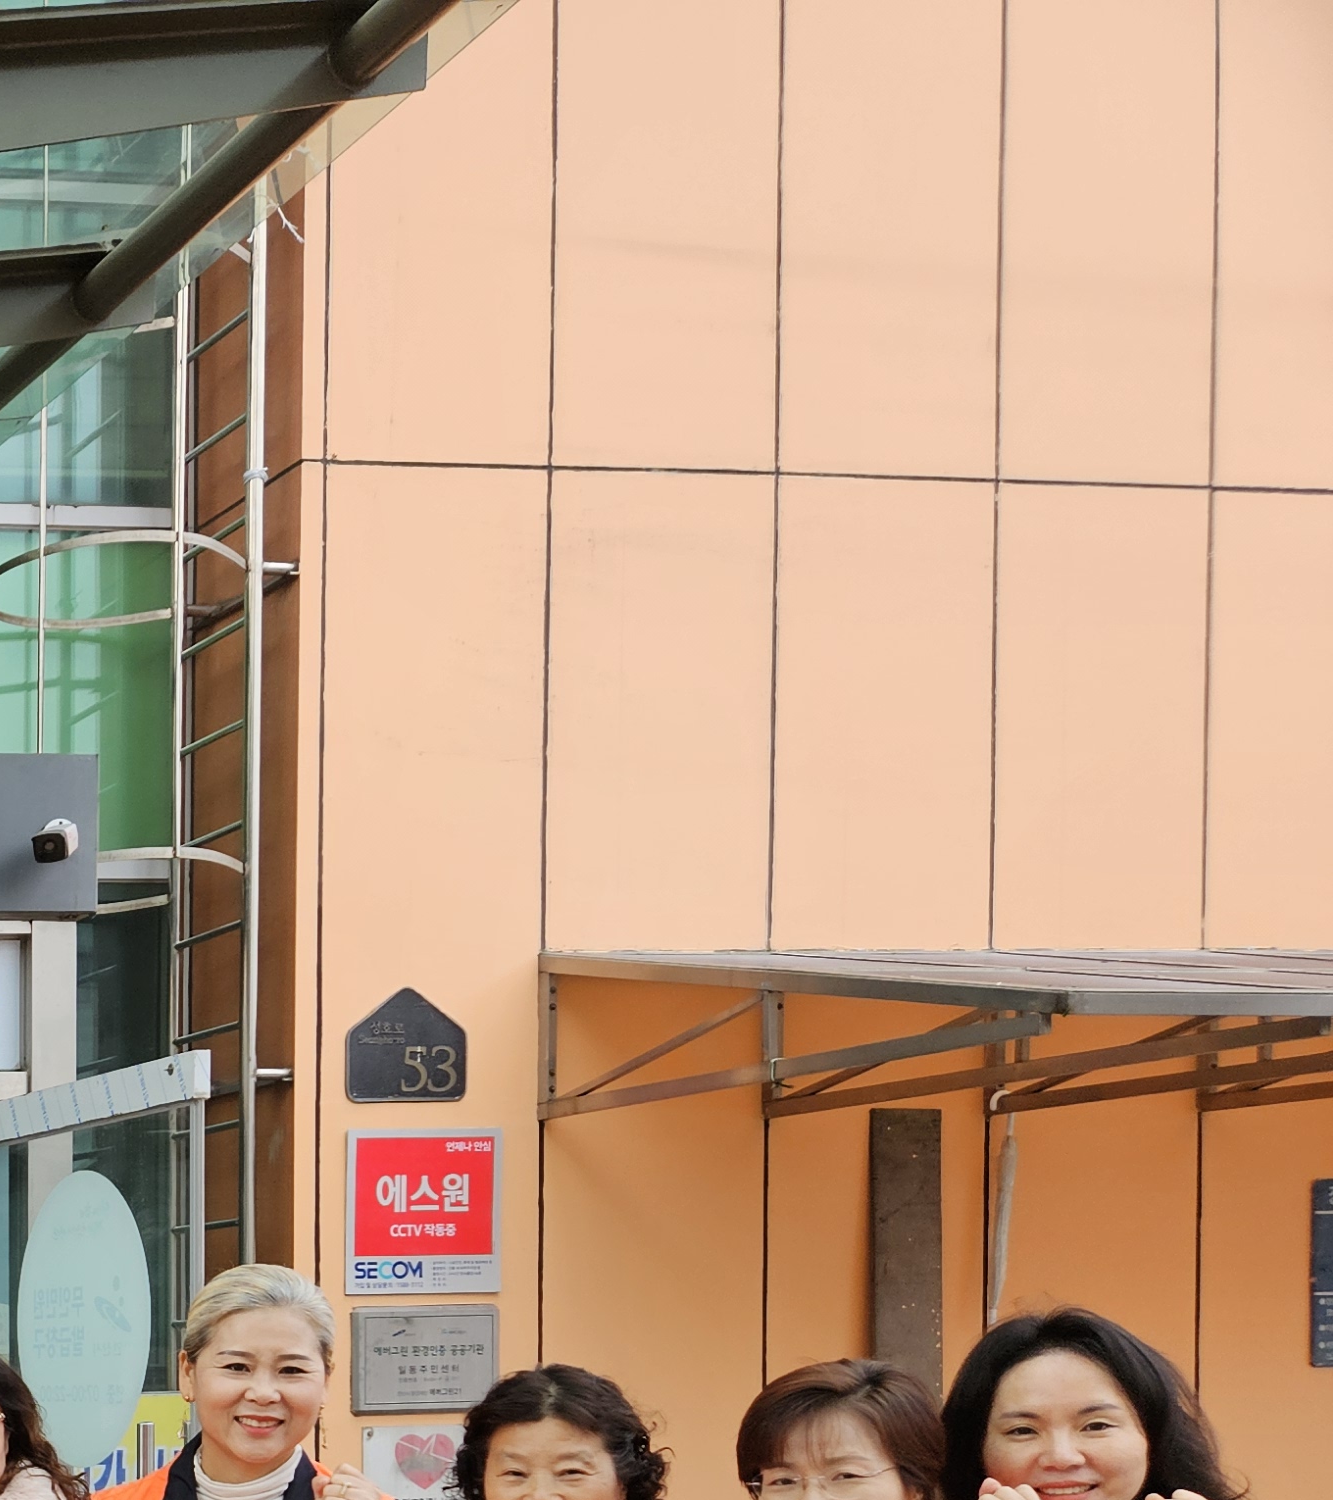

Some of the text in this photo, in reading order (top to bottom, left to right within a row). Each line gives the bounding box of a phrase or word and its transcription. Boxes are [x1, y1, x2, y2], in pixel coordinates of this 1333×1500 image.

[401, 1045, 457, 1092] 53
[446, 1141, 491, 1152] 언제나 안심
[376, 1173, 469, 1213] 에스원
[390, 1223, 457, 1237] CCTV 작동중
[354, 1261, 423, 1279] SECOM
